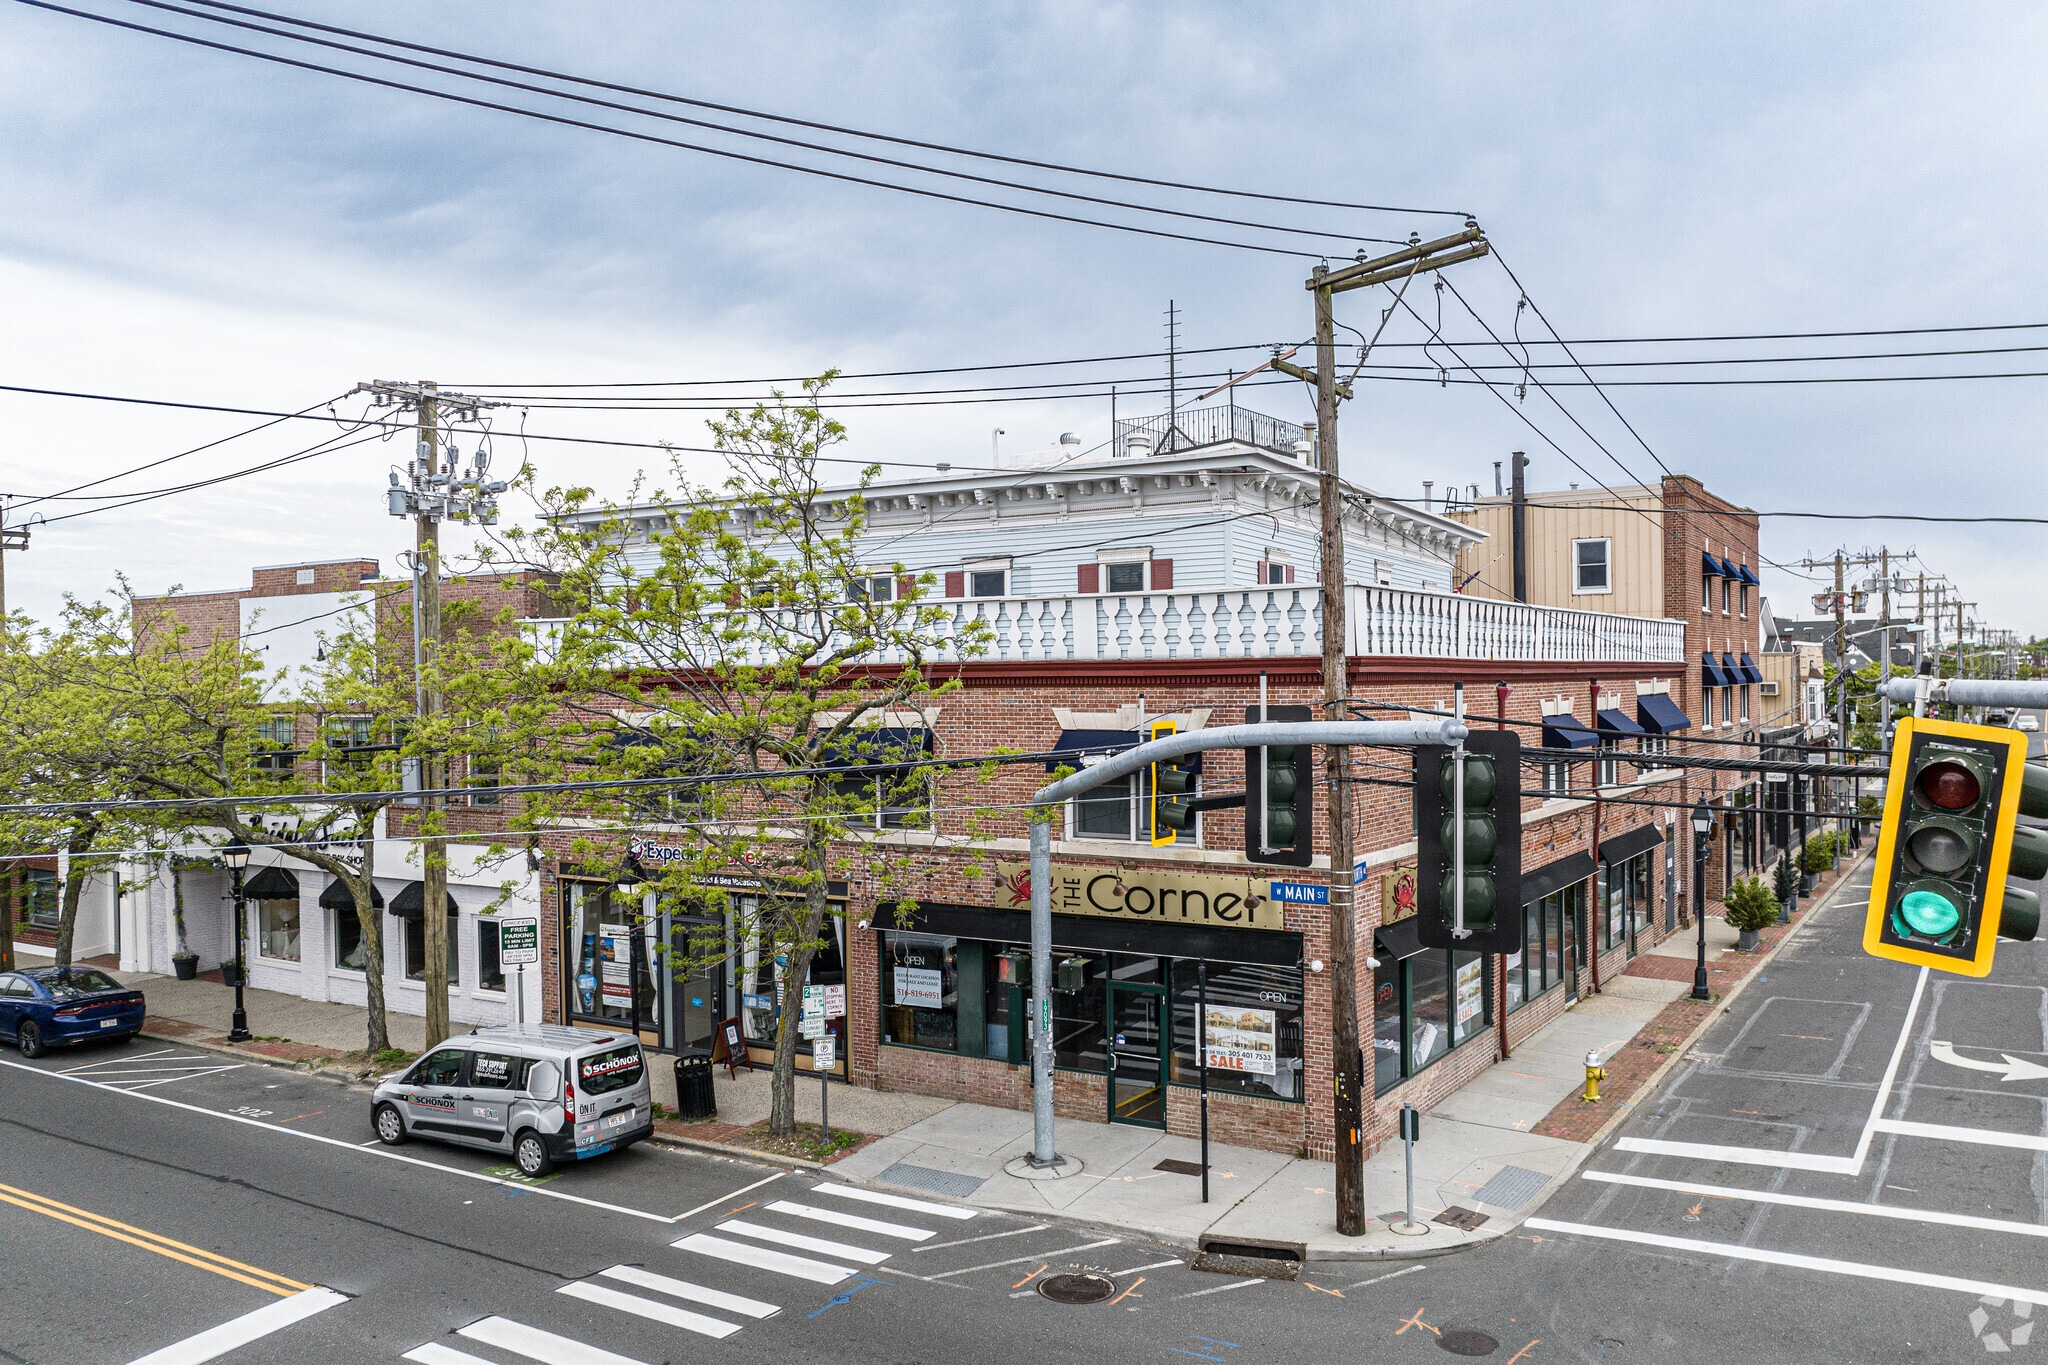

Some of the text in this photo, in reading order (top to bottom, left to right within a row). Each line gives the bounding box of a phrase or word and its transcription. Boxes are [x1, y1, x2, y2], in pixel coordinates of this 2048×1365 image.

[1063, 874, 1267, 923] THE Corner
[1285, 886, 1315, 901] MAIN
[1317, 891, 1325, 899] ST
[904, 956, 925, 966] OPEN
[804, 988, 810, 997] 2
[897, 988, 939, 1000] 516-819-6951
[1260, 991, 1287, 1003] OPEN
[1461, 1006, 1473, 1021] SALE
[593, 1053, 639, 1073] SCHÖNOX
[1210, 1055, 1244, 1070] SALE
[416, 1096, 455, 1108] SCHÖNOX
[228, 1106, 273, 1118] 302
